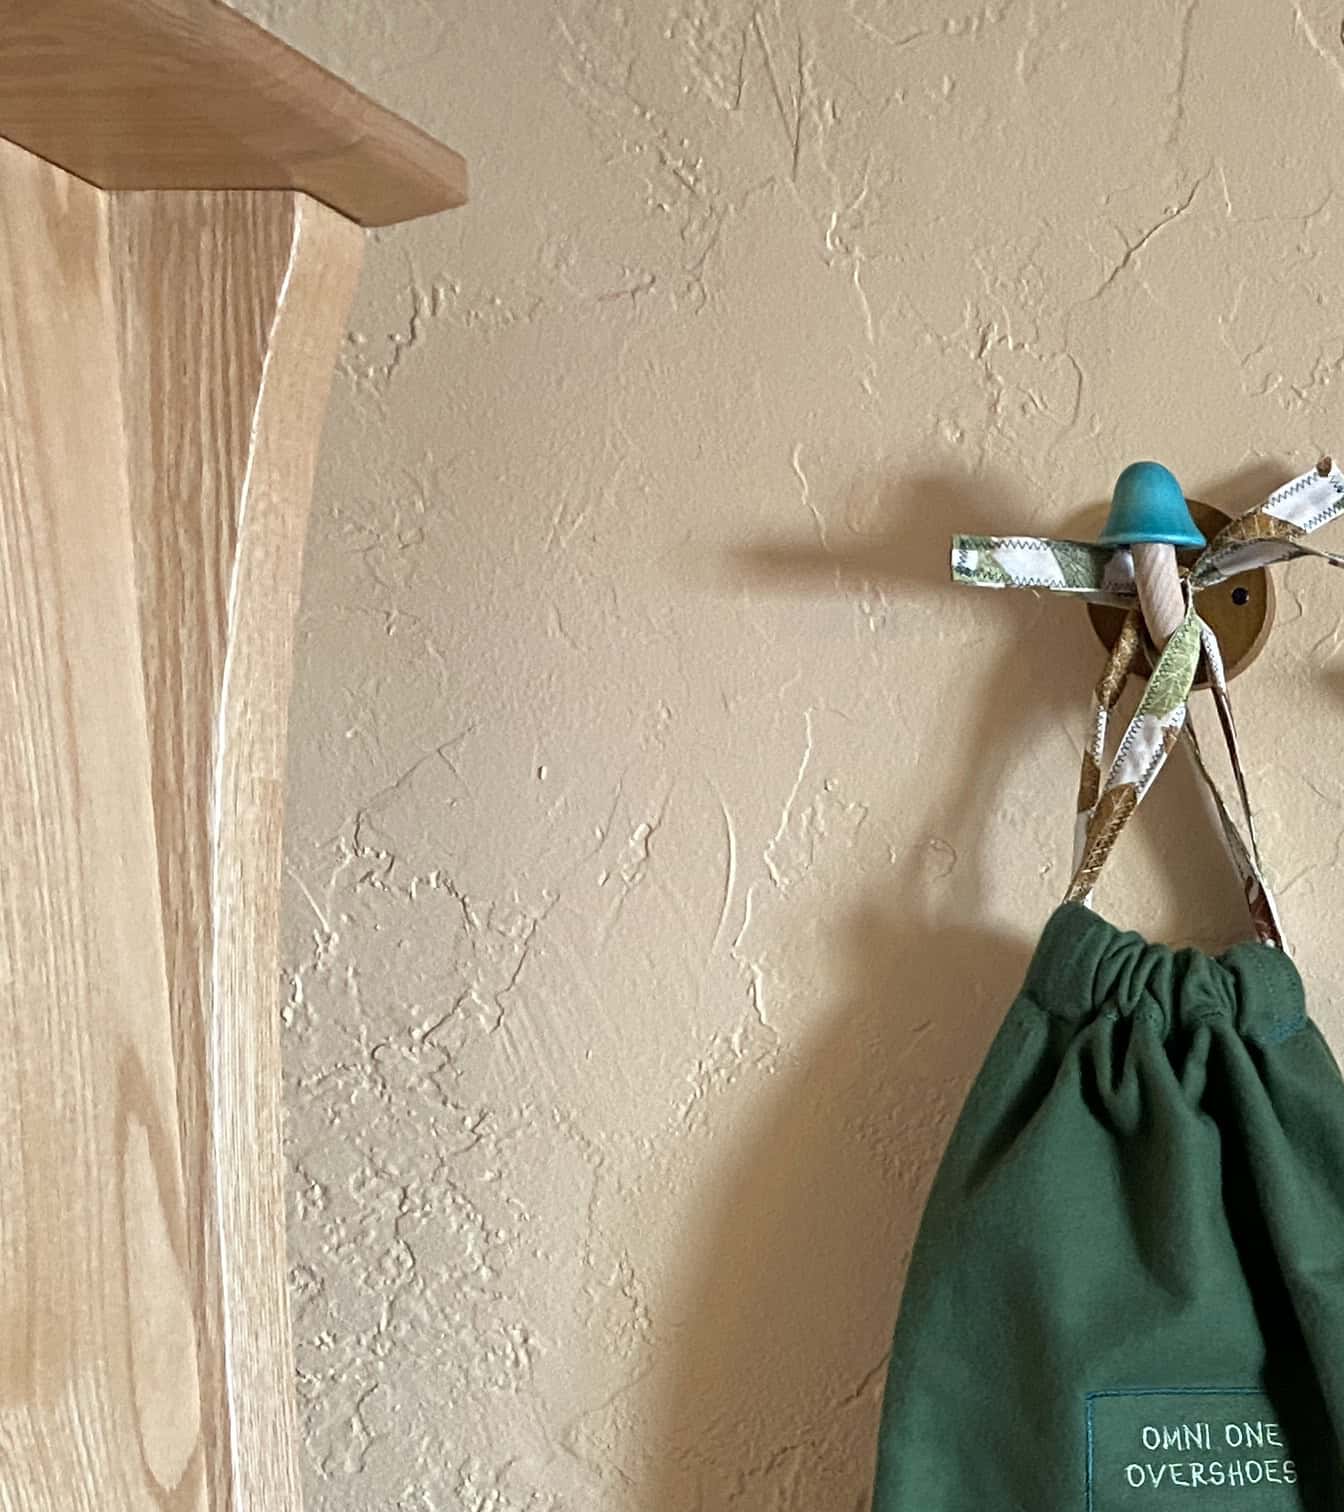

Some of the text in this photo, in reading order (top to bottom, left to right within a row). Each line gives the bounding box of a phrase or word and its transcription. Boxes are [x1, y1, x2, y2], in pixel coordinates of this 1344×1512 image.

[1142, 1421, 1283, 1450] OMNI ONE
[1125, 1459, 1297, 1487] OVERSHOES
